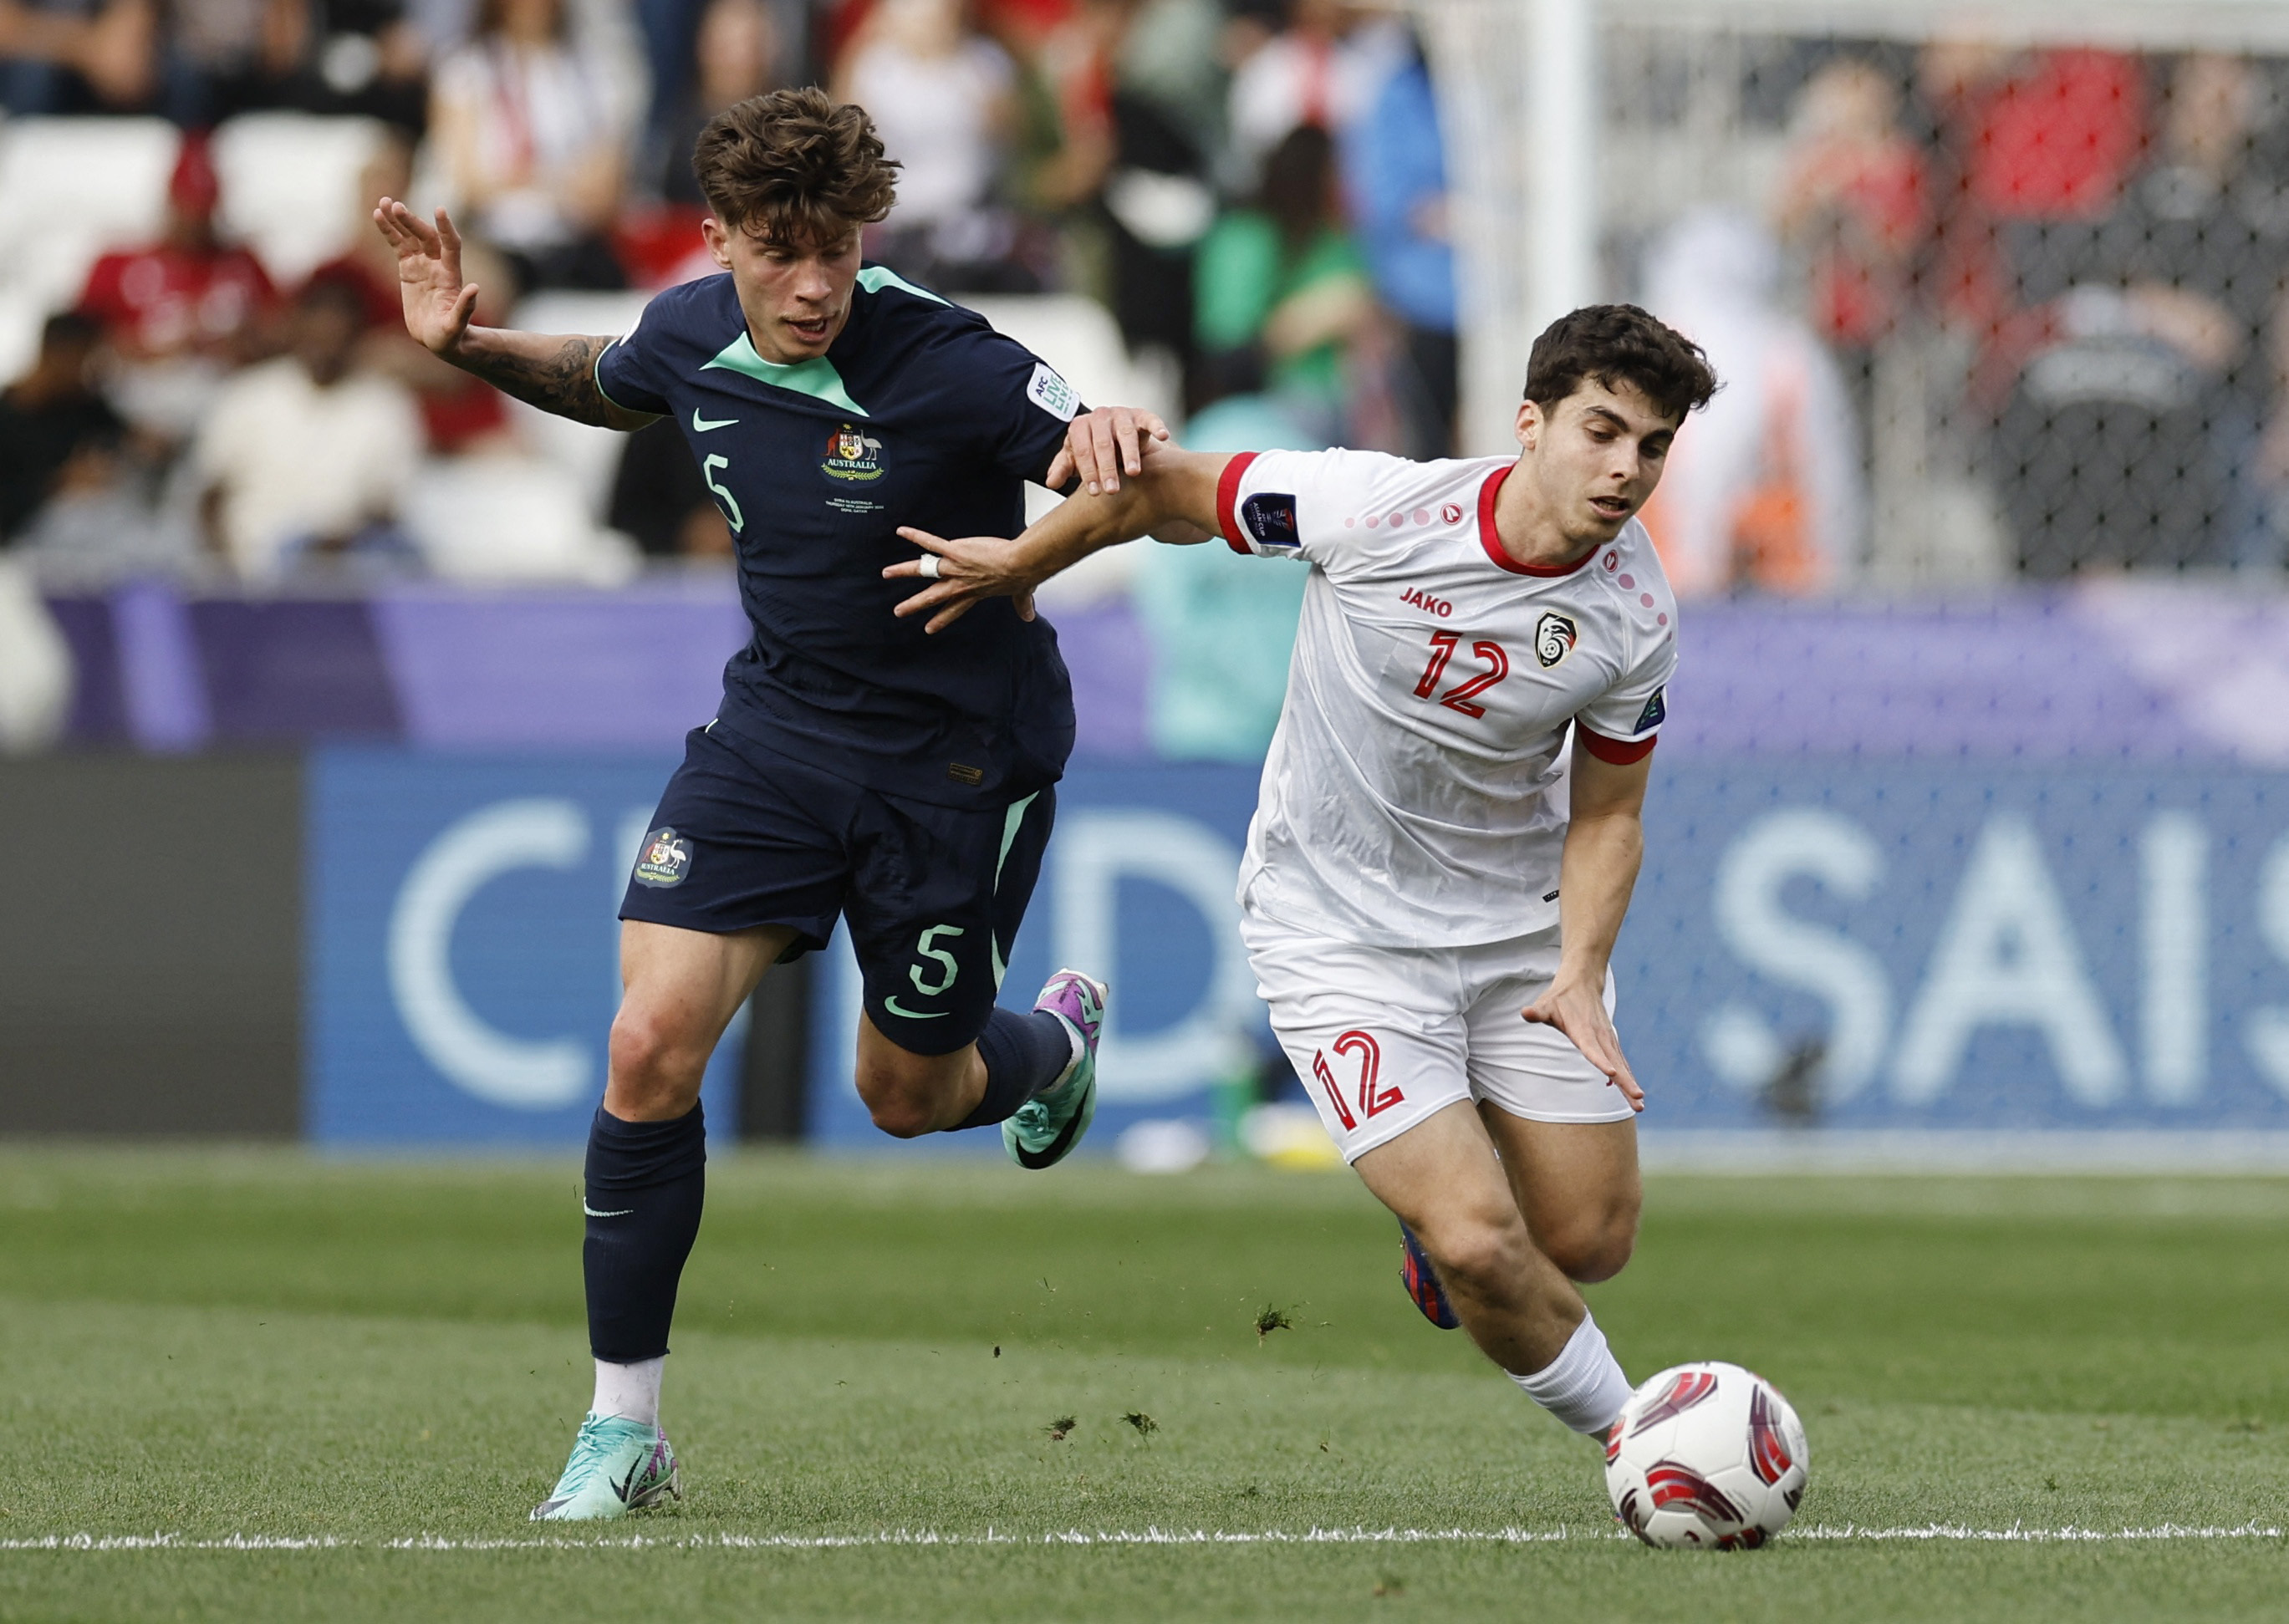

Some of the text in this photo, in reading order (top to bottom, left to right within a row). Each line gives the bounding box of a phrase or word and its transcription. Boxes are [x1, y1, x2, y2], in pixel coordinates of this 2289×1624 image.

[1036, 376, 1048, 397] AFC
[1043, 374, 1062, 406] LIVE
[828, 458, 877, 470] AUSTRALIA
[703, 453, 744, 533] 5
[1399, 587, 1453, 618] JAKO
[1413, 629, 1509, 720] 12
[640, 863, 675, 876] AUSTRALIA
[909, 924, 965, 996] 5
[1701, 807, 2289, 1108] SAI
[1312, 1030, 1405, 1132] 12
